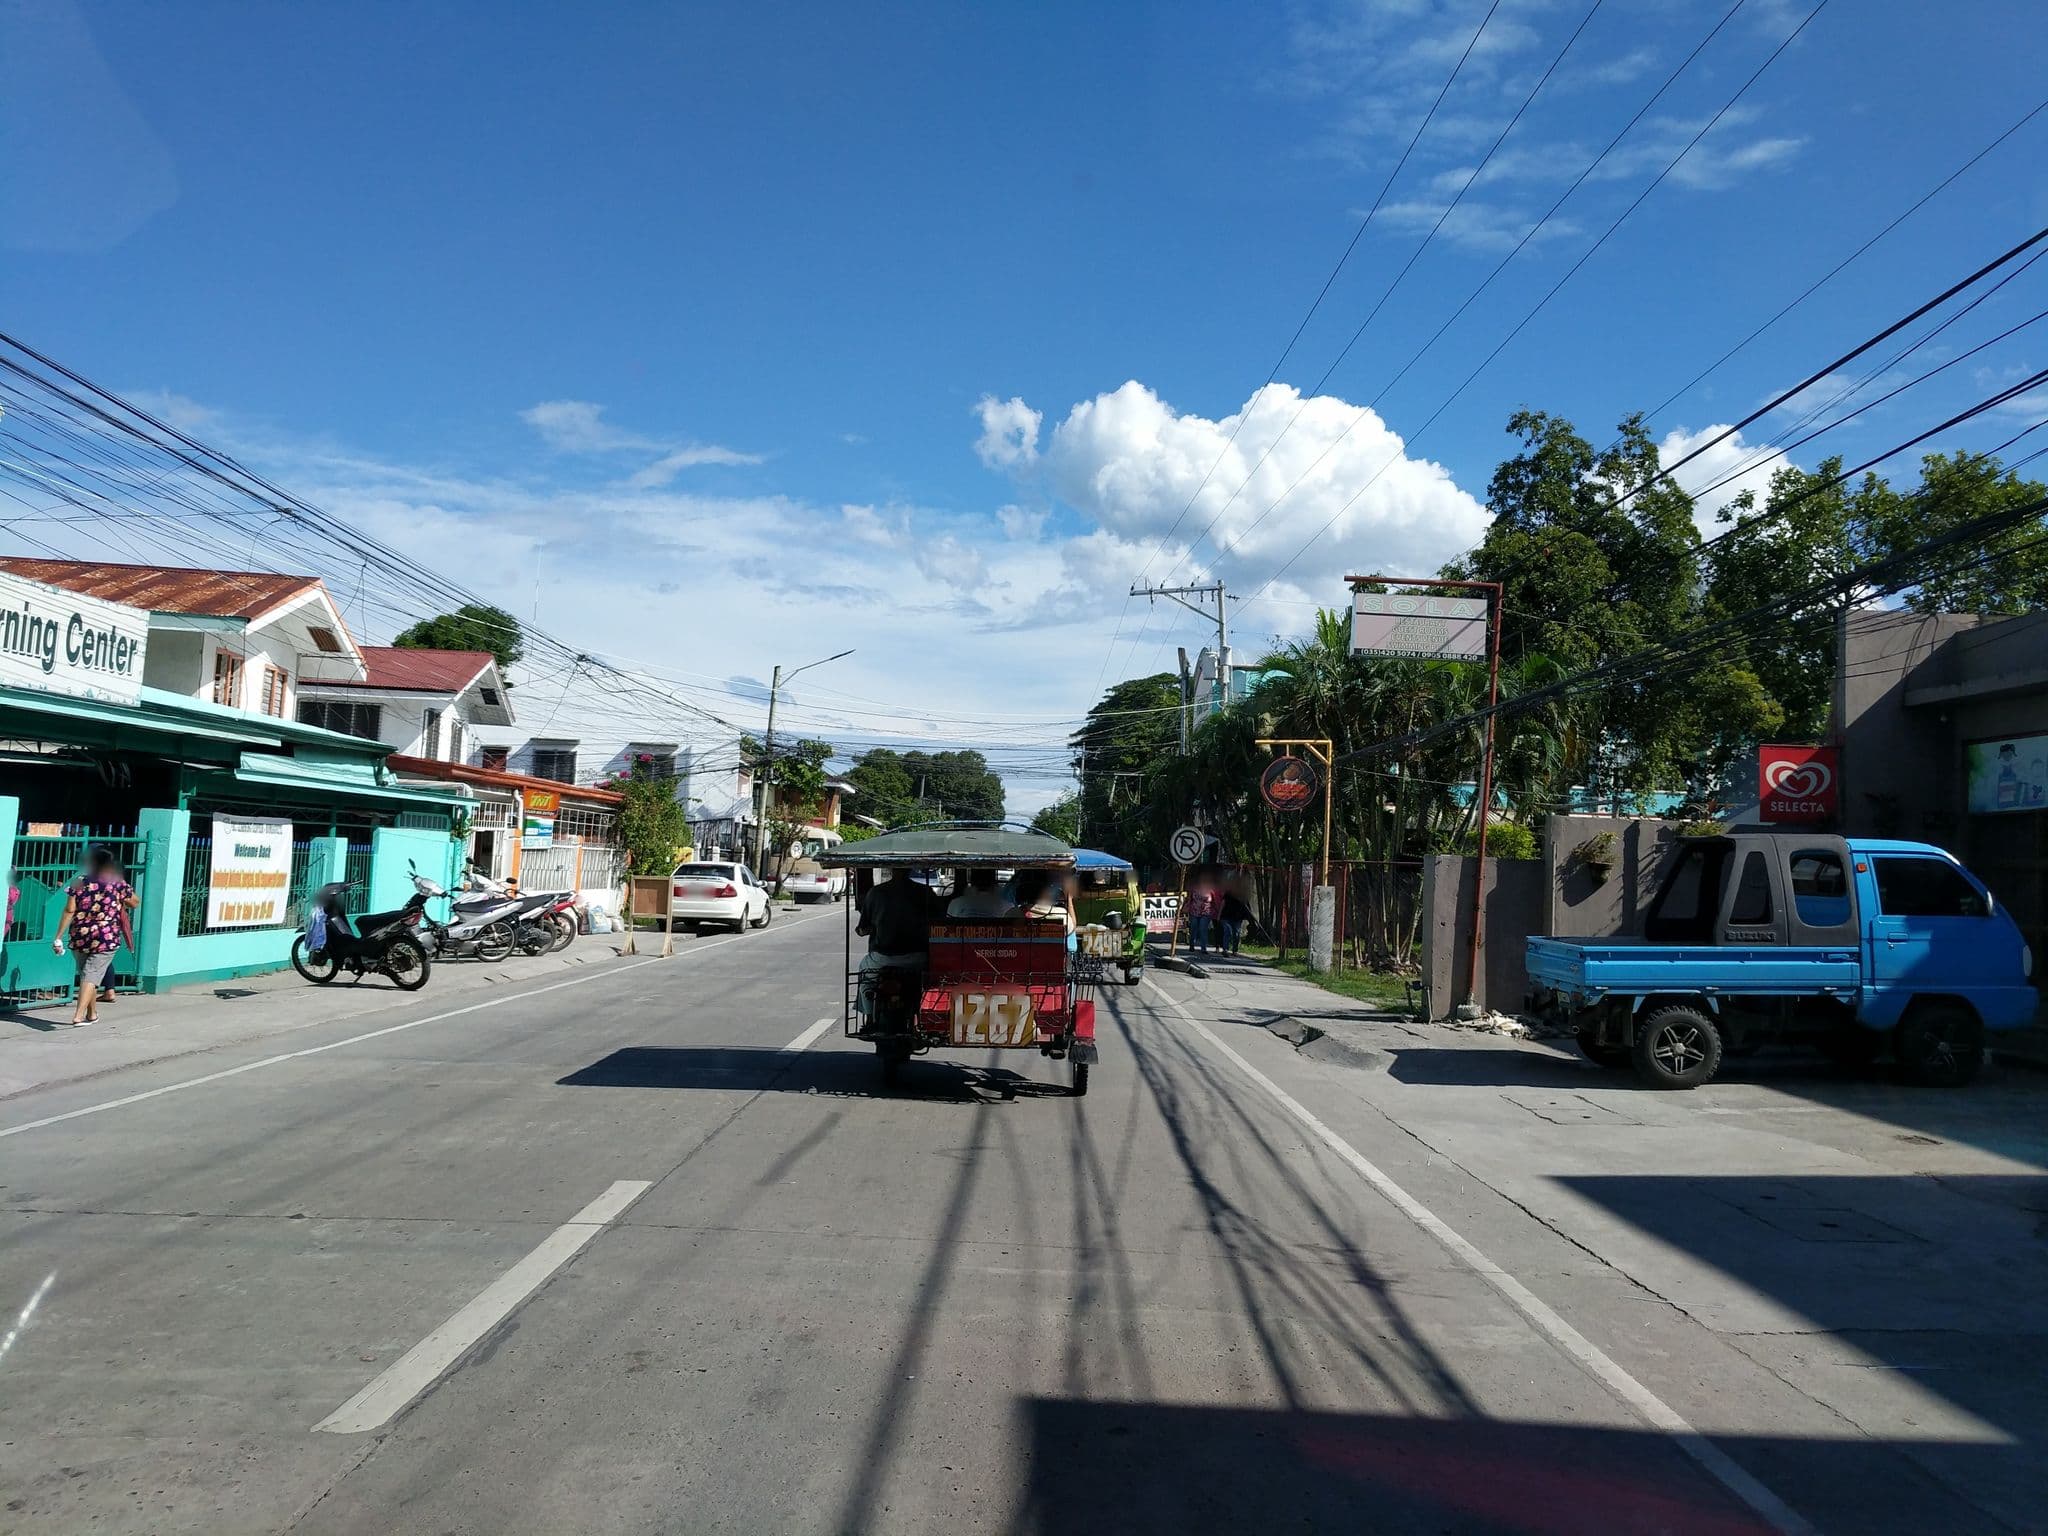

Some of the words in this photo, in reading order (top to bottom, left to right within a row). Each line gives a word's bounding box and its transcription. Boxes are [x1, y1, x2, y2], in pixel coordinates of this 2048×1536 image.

[1363, 597, 1475, 616] SOLA
[66, 612, 138, 676] Center
[1463, 653, 1478, 661] 420
[1770, 801, 1825, 813] SELECTA
[1145, 898, 1179, 909] NO
[1144, 909, 1177, 919] PARKIN
[953, 994, 1031, 1045] 1267
